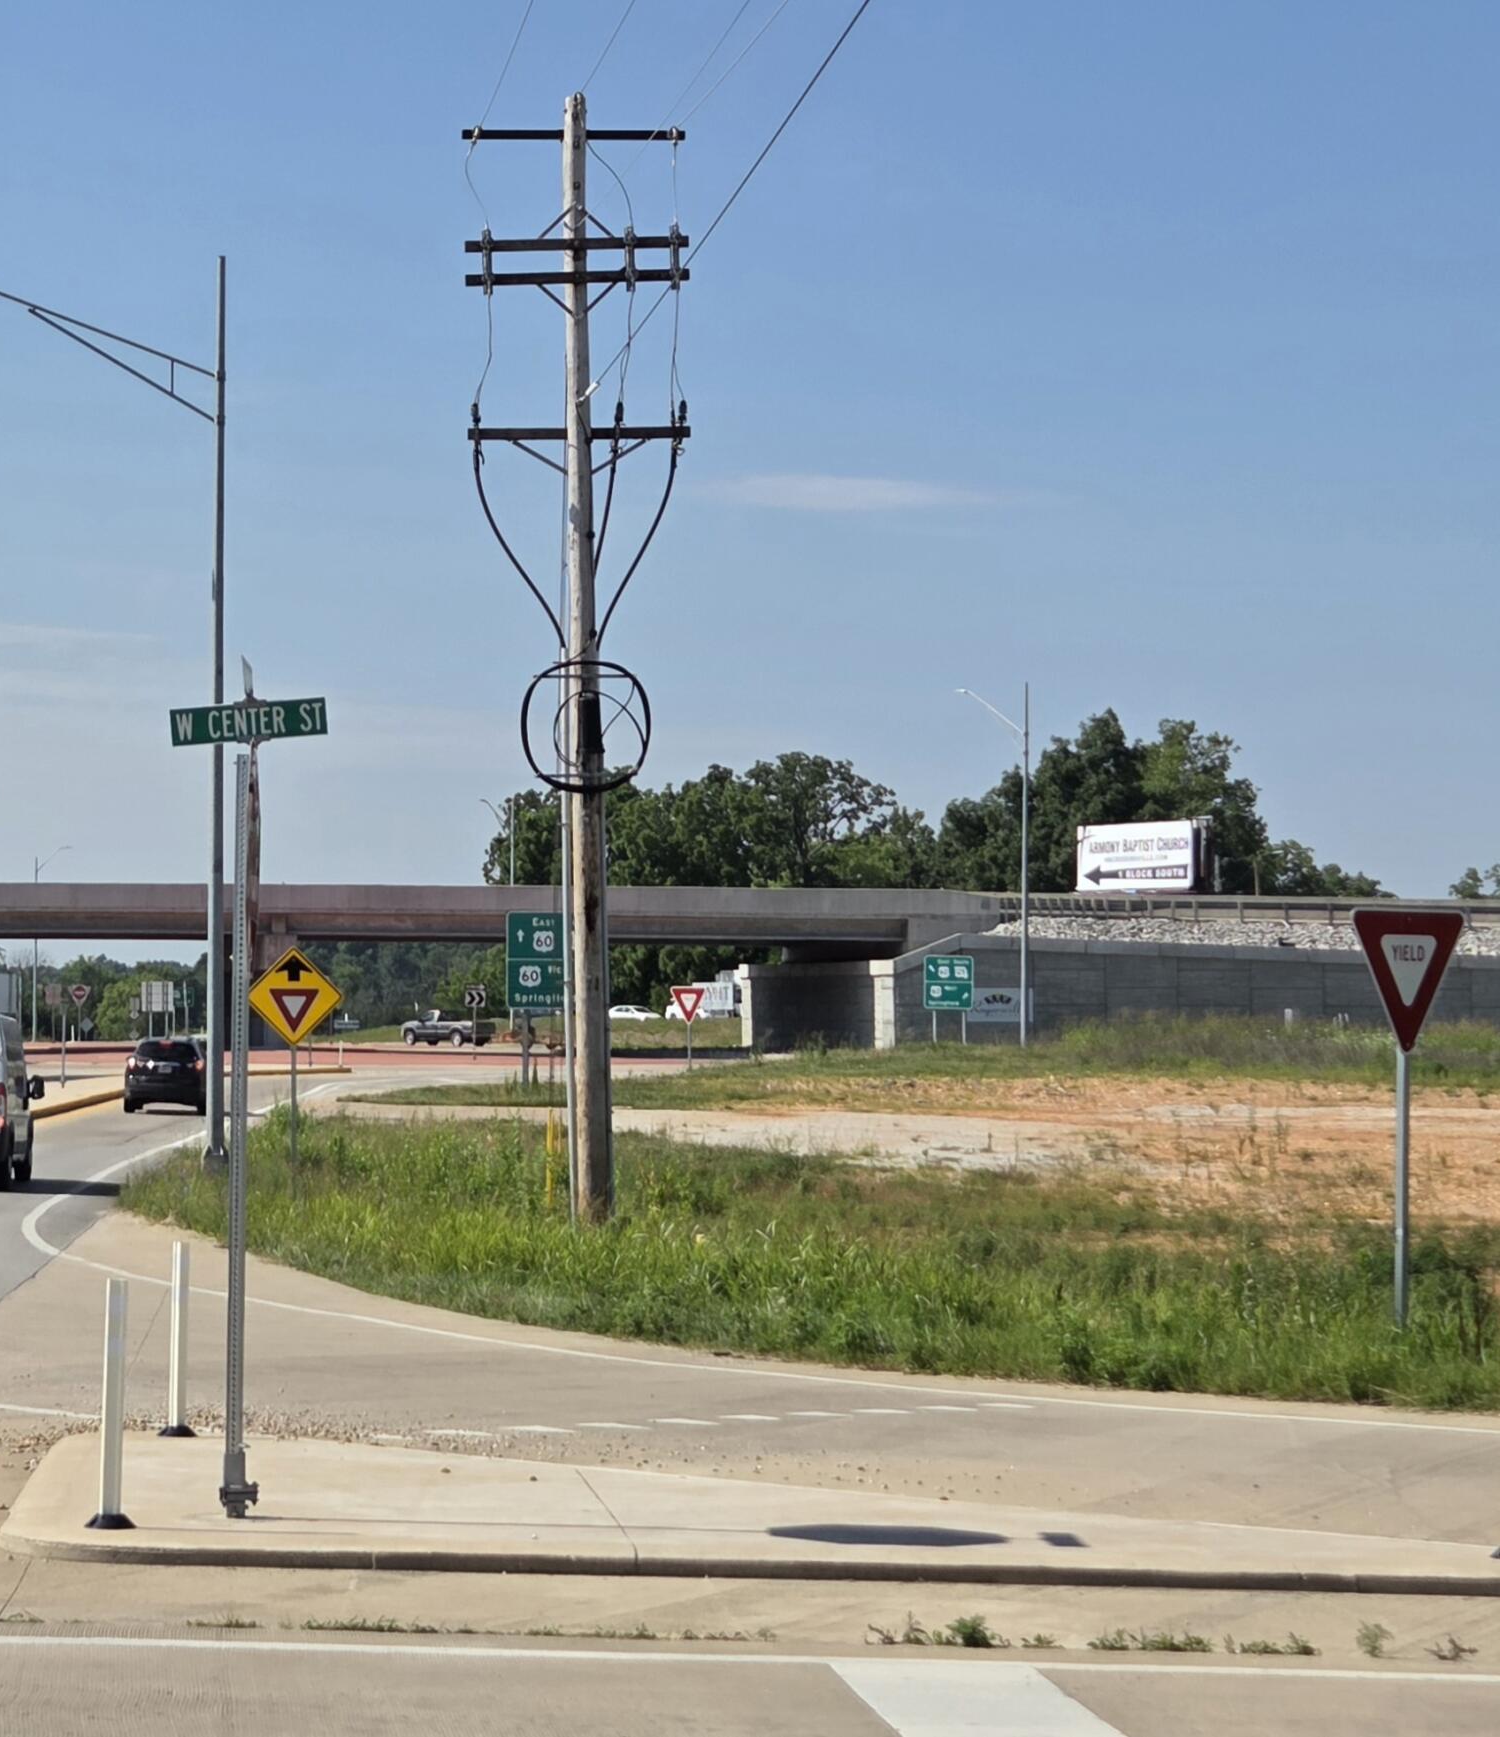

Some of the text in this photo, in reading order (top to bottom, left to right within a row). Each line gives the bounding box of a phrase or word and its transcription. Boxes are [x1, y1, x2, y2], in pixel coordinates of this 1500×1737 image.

[175, 702, 323, 742] W CENTER ST
[1122, 838, 1155, 852] BAPTIST
[1156, 836, 1189, 851] CHURCH
[1125, 868, 1153, 878] BLOCK
[1155, 867, 1185, 877] SOUTH
[535, 935, 552, 948] 60
[1391, 944, 1425, 962] YIELD
[521, 970, 539, 982] 60
[514, 993, 564, 1005] Springfi
